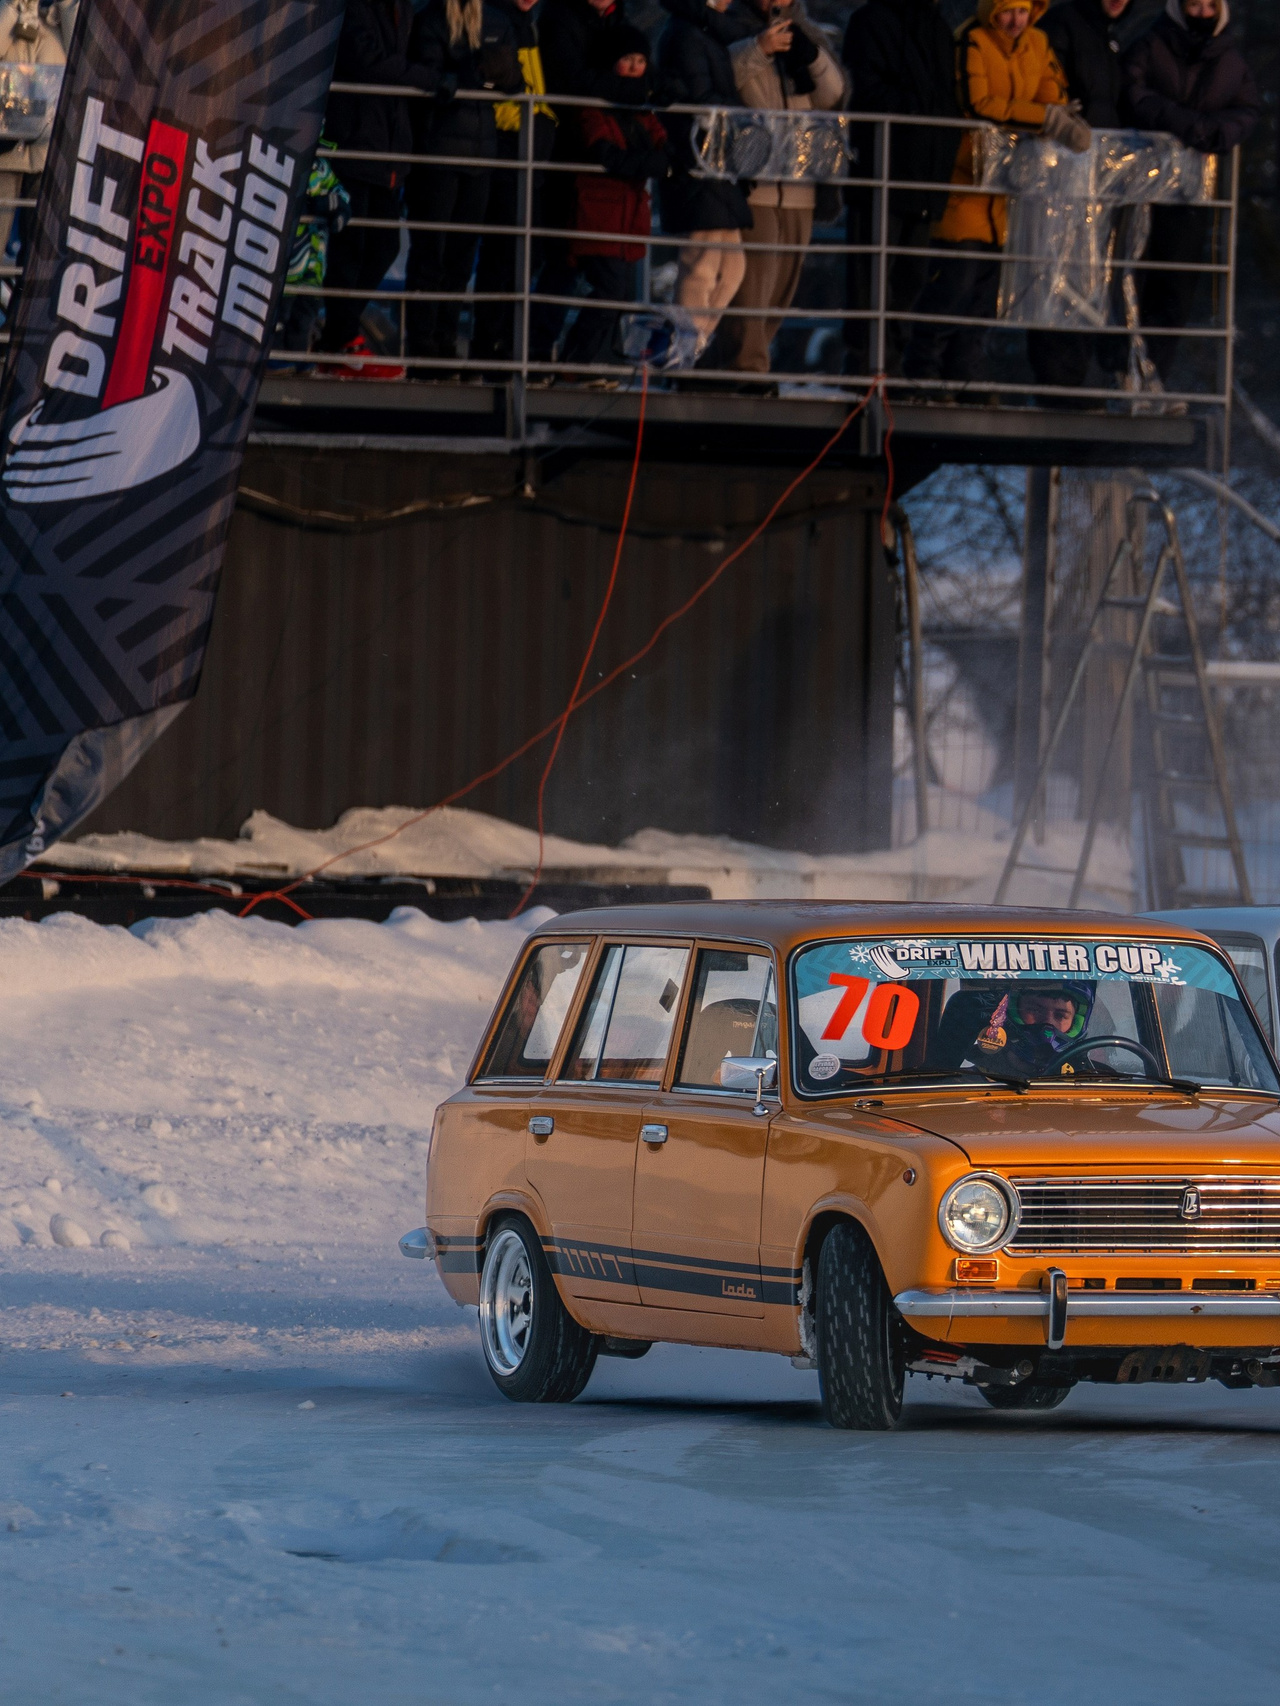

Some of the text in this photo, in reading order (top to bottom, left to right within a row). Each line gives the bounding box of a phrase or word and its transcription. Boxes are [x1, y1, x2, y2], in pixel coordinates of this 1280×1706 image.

[134, 151, 178, 274] EXPO
[43, 96, 145, 398] DRIFT
[896, 947, 955, 961] DRIFT
[926, 959, 952, 967] EXPO
[957, 942, 1162, 975] WINTER CUP
[820, 972, 920, 1051] 70
[721, 1279, 757, 1299] Lada
